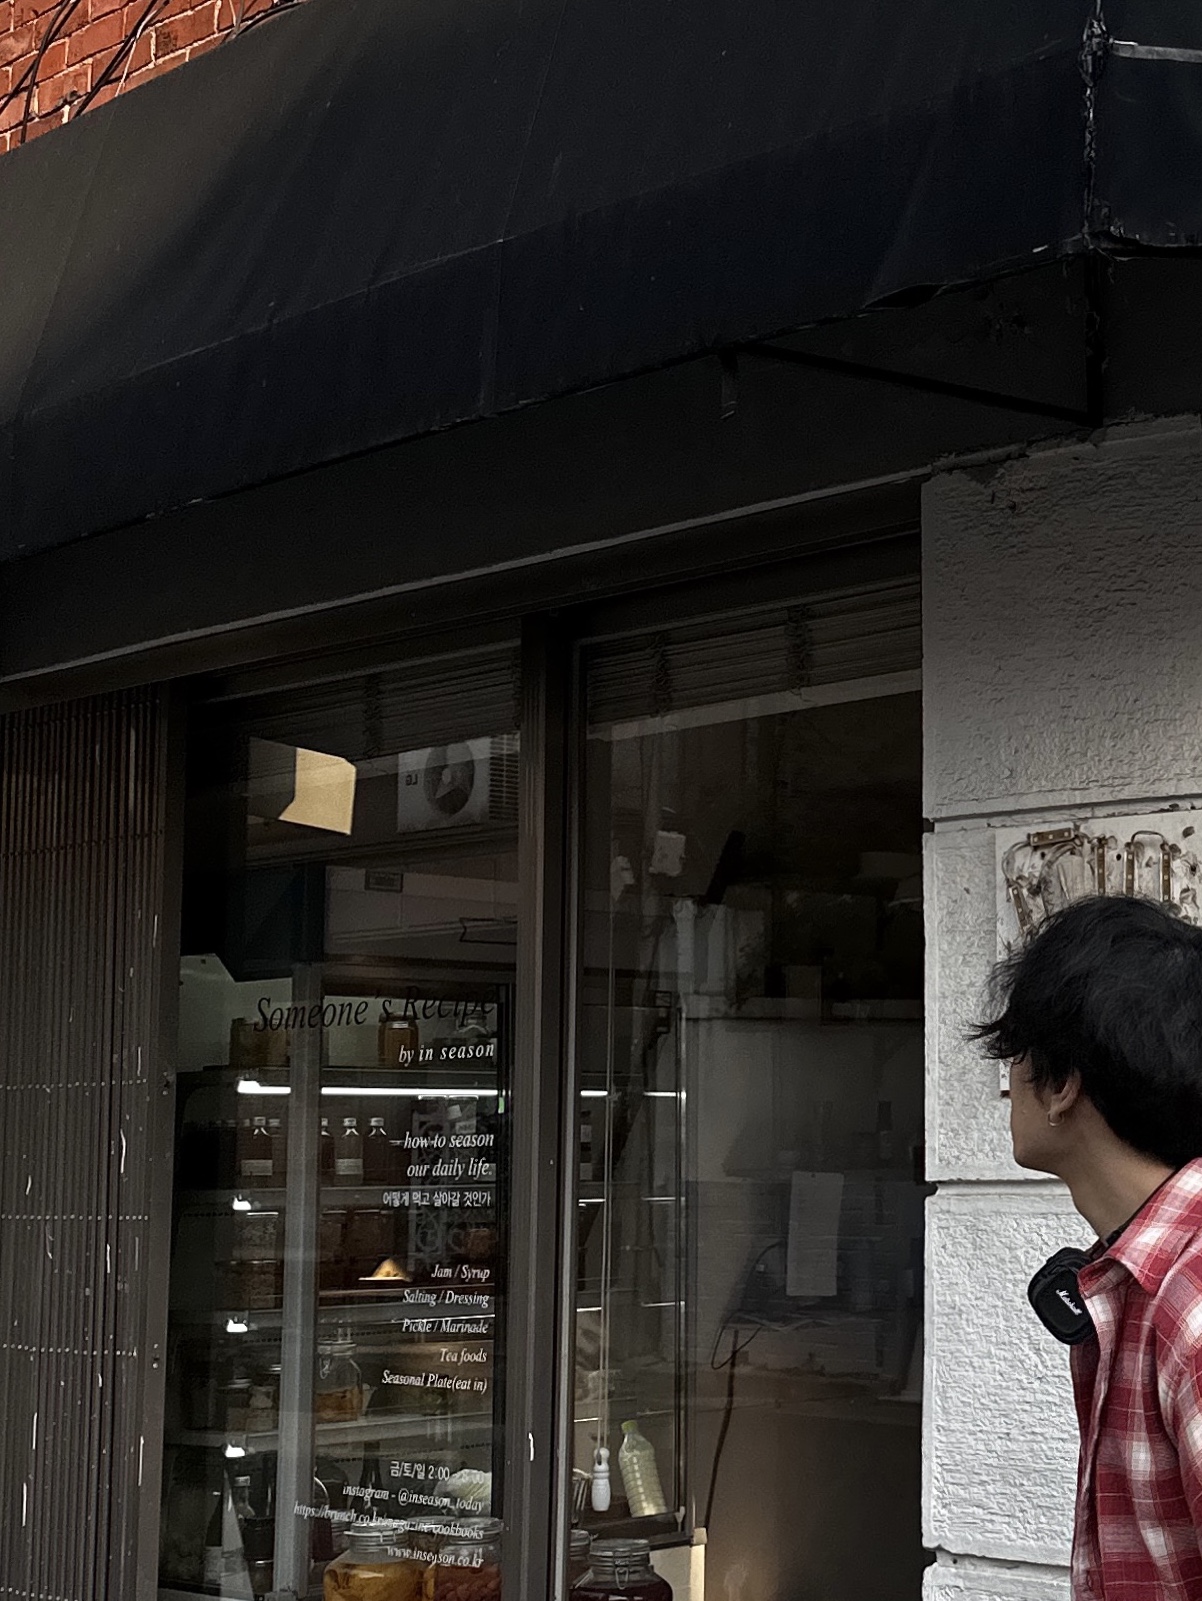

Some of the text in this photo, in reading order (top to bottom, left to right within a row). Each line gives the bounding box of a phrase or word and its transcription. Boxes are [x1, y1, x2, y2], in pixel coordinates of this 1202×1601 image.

[402, 985, 496, 1028] Recipe
[398, 1043, 494, 1067] by in season
[403, 1131, 494, 1149] how to season
[406, 1157, 493, 1180] our daily life.
[382, 1191, 491, 1207] 어떻게 먹고 살아갈 것인가
[431, 1264, 452, 1278] Jam
[461, 1264, 490, 1282] Syrup
[402, 1289, 437, 1307] Salting
[445, 1290, 490, 1308] Dressing
[402, 1318, 432, 1332] Pickle
[440, 1318, 489, 1334] Marinade
[440, 1347, 487, 1366] Tea foods
[381, 1369, 425, 1387] Seasonal
[472, 1377, 487, 1395] in)
[428, 1465, 450, 1481] 2:00
[342, 1482, 389, 1506] instagram
